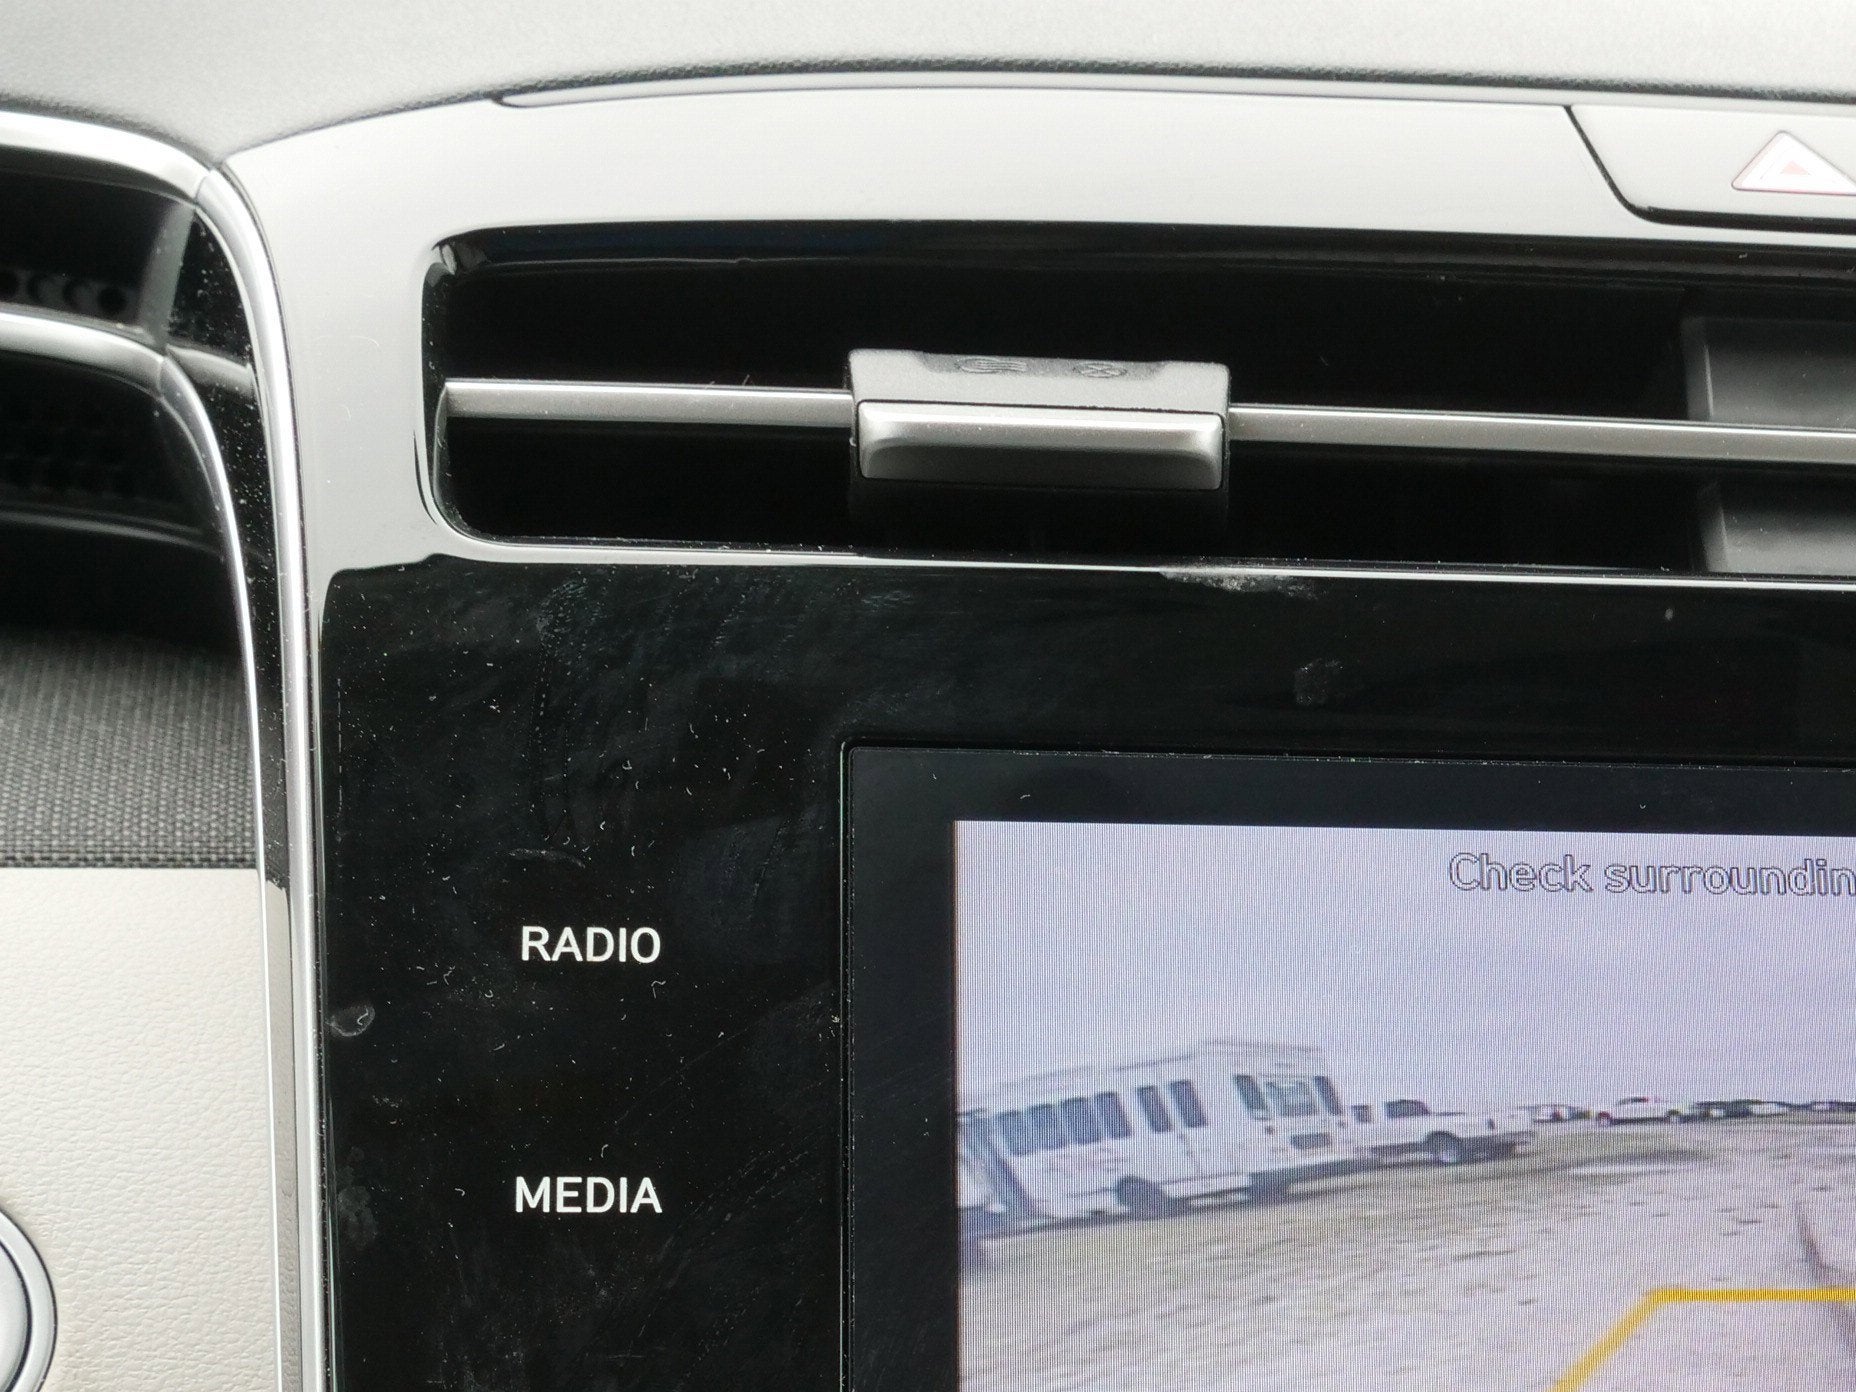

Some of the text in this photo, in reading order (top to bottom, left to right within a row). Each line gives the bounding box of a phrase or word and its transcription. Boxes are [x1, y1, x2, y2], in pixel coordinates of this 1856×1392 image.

[1448, 852, 1593, 893] Check
[521, 925, 662, 964] RADIO
[515, 1176, 663, 1214] MEDIA
